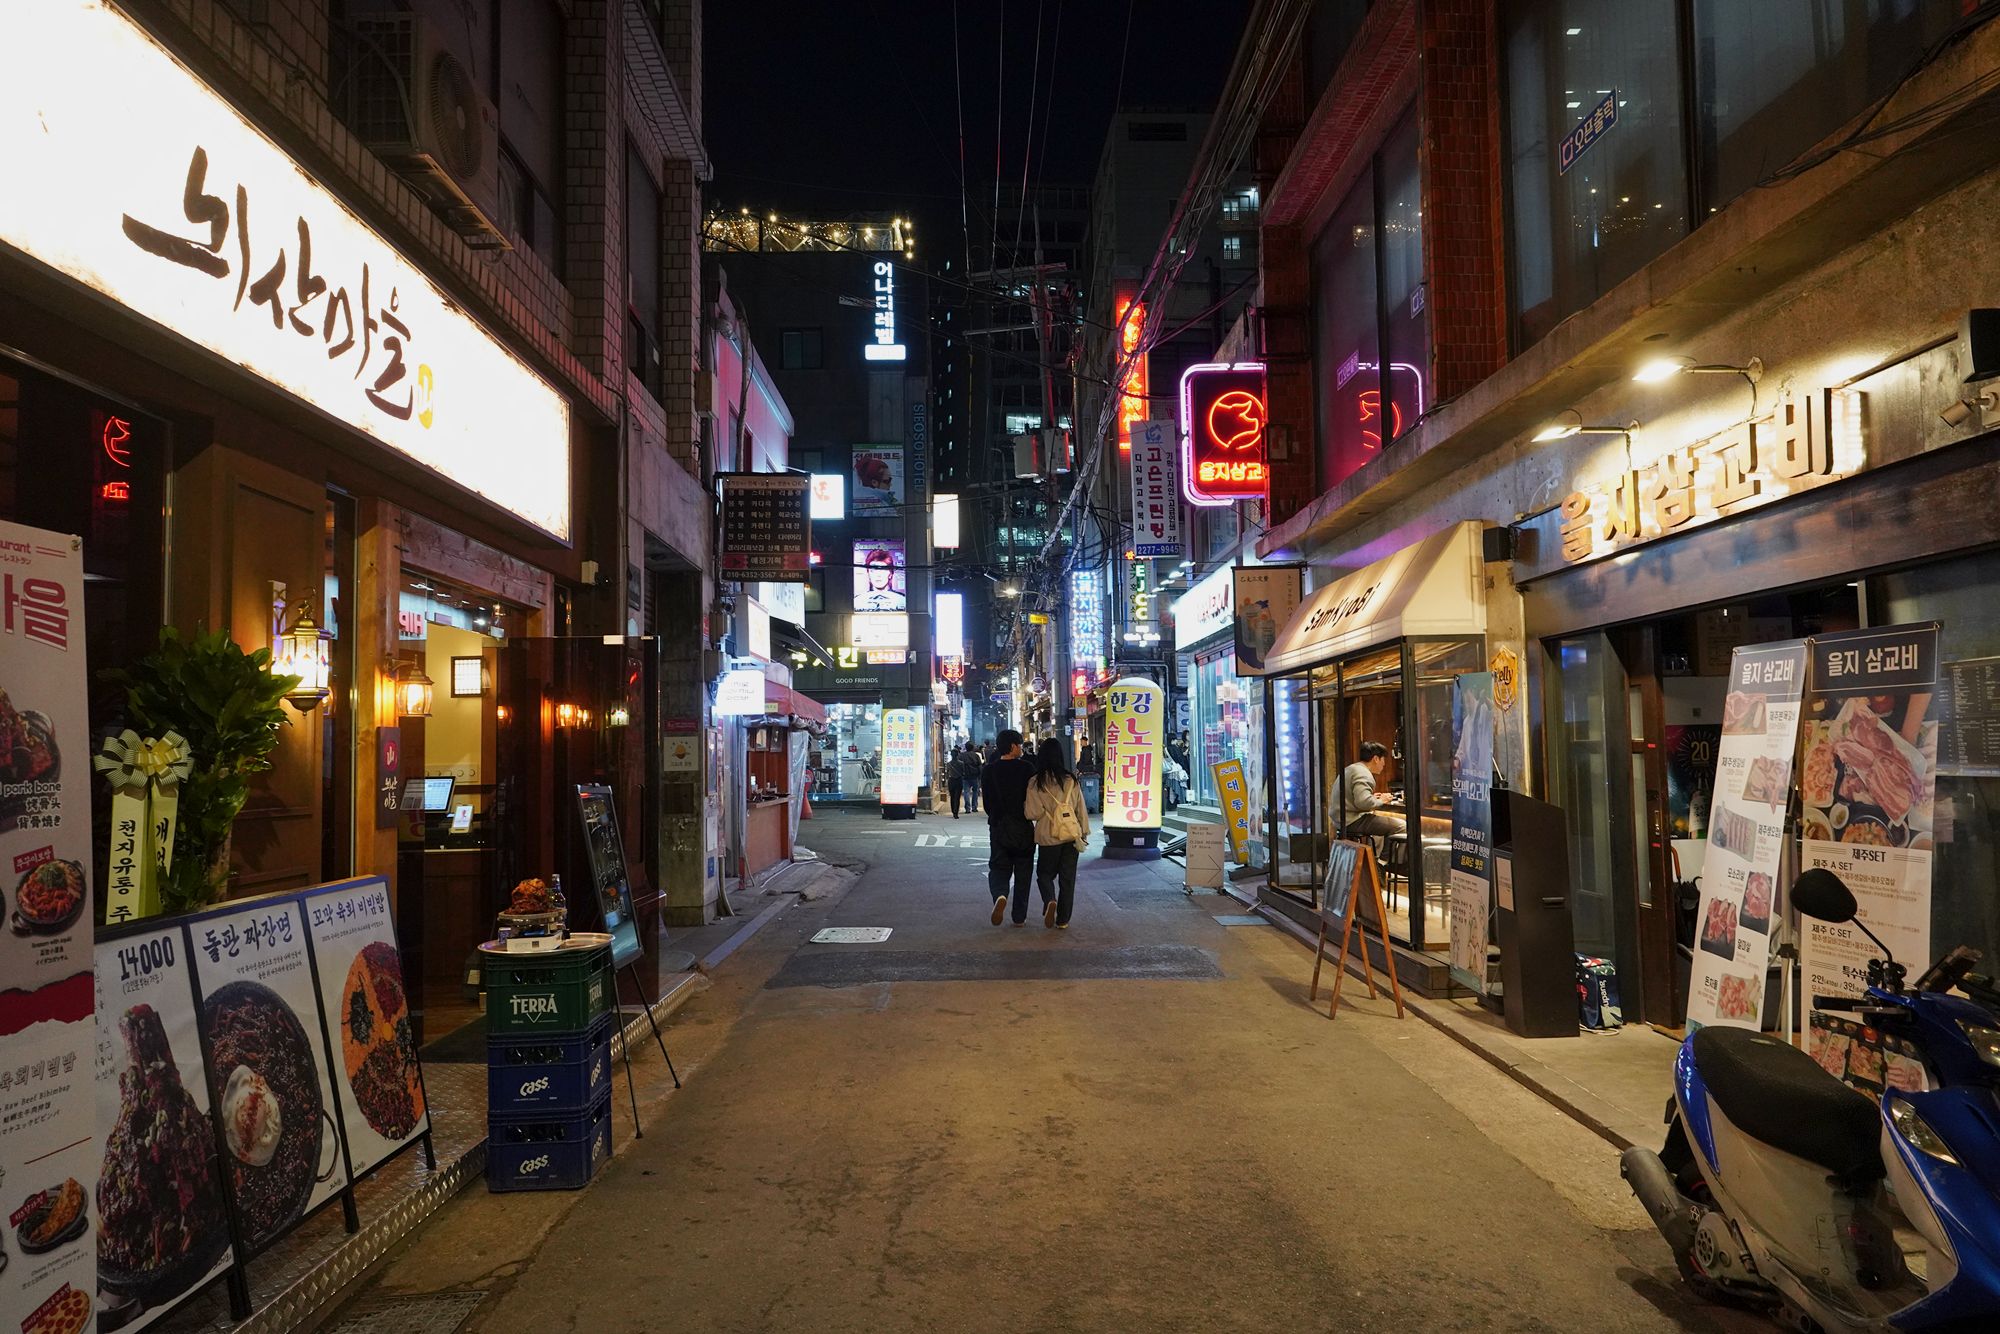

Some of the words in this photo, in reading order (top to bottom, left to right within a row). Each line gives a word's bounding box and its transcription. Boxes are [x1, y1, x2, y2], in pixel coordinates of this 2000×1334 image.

[912, 453, 926, 491] HOTEL
[1199, 461, 1265, 482] 을지삼교
[1560, 388, 1834, 562] 을지삼교비
[1137, 543, 1180, 556] 2277-9945
[1167, 535, 1178, 543] 2F
[1304, 582, 1381, 632] SamKyoBi
[1827, 650, 1859, 677] 을지
[1865, 643, 1918, 673] 삼교비
[1742, 662, 1761, 685] 을지
[1763, 659, 1794, 683] 삼교비
[1110, 691, 1152, 714] 한강
[1106, 720, 1120, 805] 술마시는
[1120, 717, 1153, 823] 노래방
[5, 782, 32, 797] pork
[34, 781, 61, 794] bone
[1812, 858, 1829, 869] 제주
[1830, 861, 1837, 870] A
[1838, 862, 1854, 872] SET
[1852, 848, 1887, 862] 제주SET
[357, 891, 385, 917] 비빔밥
[202, 923, 240, 964] 돌판
[242, 912, 294, 952] 짜장면
[1811, 923, 1828, 934] 제주
[1829, 928, 1836, 936] C
[1837, 929, 1852, 940] SET
[117, 935, 175, 982] 14,000
[1842, 965, 1868, 982] 특수부
[510, 994, 558, 1015] TERRA
[520, 1076, 550, 1097] Cass
[520, 1155, 549, 1175] Cass
